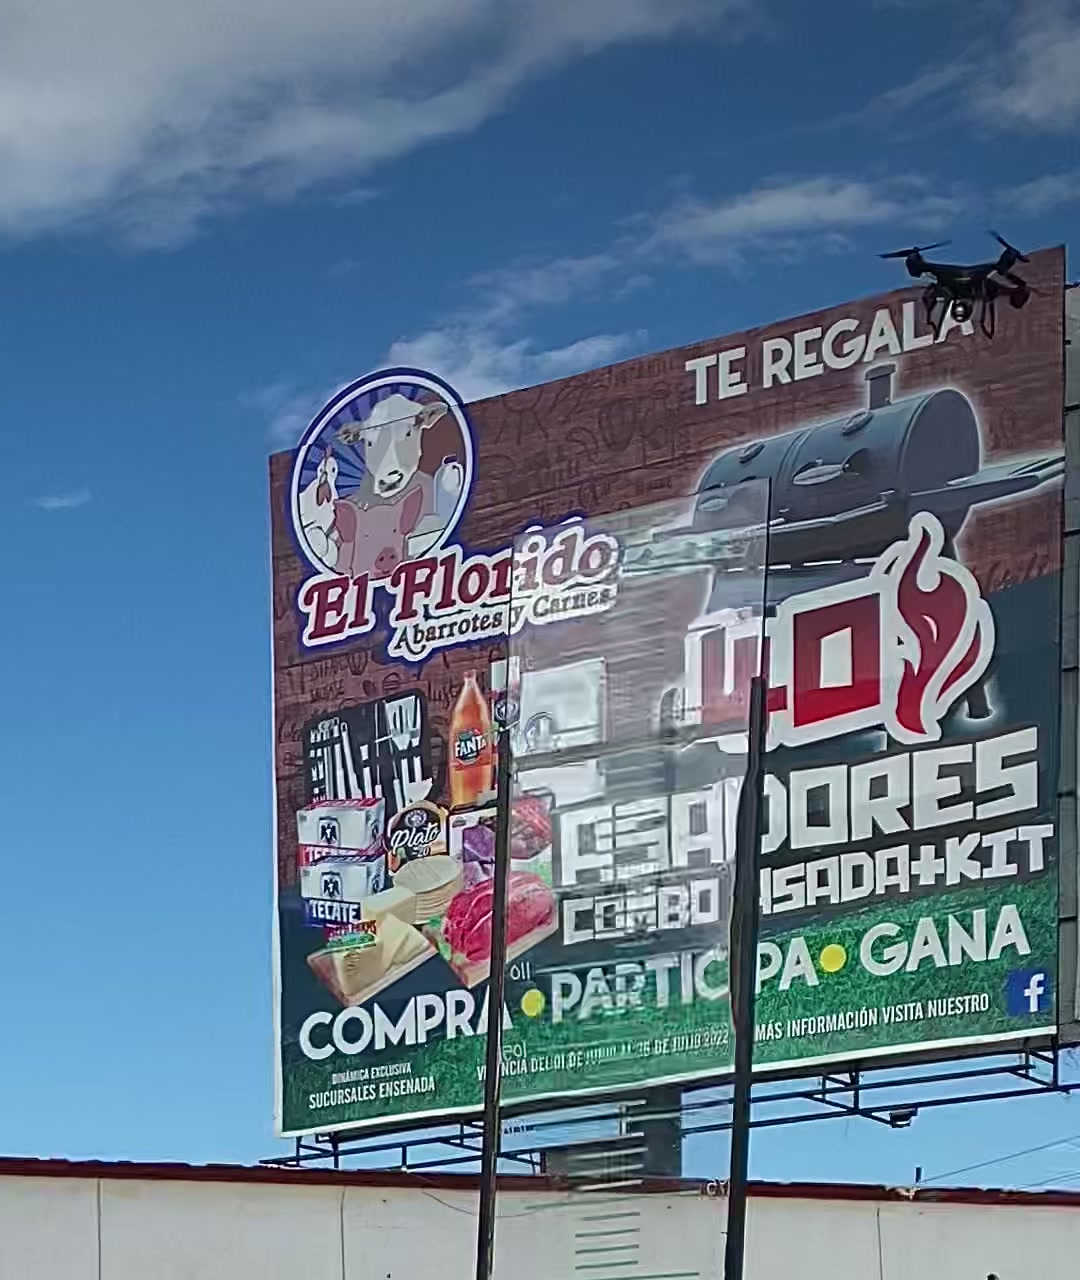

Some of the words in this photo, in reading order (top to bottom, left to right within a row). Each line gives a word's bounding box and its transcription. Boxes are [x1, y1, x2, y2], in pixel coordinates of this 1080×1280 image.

[685, 346, 748, 406] TE
[763, 297, 976, 389] REGALA
[303, 573, 370, 640] El
[390, 527, 615, 622] Florido
[394, 609, 503, 655] Abarrotes
[509, 604, 522, 628] y
[532, 588, 613, 619] Carnes
[455, 731, 487, 757] FANTA
[390, 823, 441, 851] Plato
[309, 899, 360, 923] TECATE
[299, 985, 513, 1060] COMPRA
[552, 937, 820, 1024] PARTICPA
[859, 904, 1032, 977] GANA
[755, 1018, 783, 1042] MÁS
[787, 1006, 878, 1038] INFORMACIÓN
[883, 1000, 924, 1024] VISITA
[928, 993, 990, 1018] NUESTRO
[371, 1062, 412, 1079] EXCLUSIVA
[309, 1084, 377, 1110] SUCURSALES
[379, 1075, 436, 1099] ENSENADA
